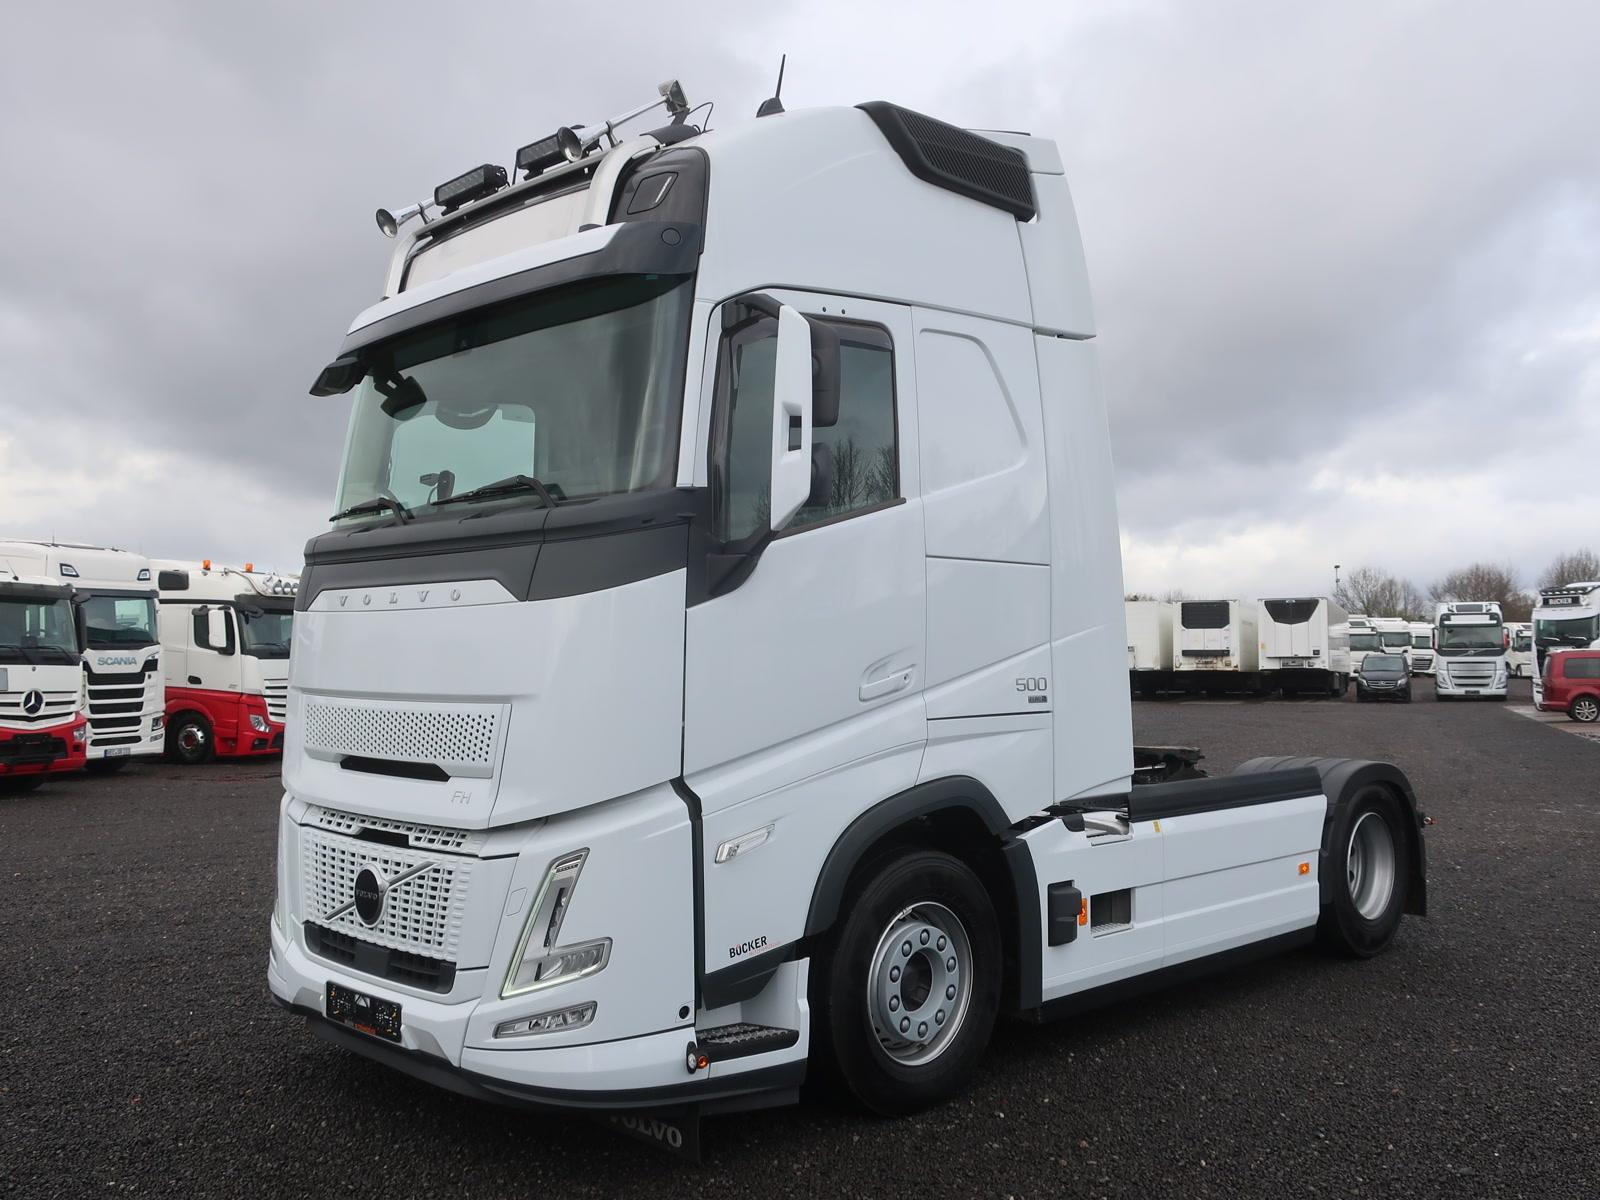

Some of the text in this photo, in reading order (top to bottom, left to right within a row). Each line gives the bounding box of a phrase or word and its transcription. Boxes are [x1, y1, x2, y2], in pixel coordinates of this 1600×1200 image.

[338, 588, 462, 607] VOLVO
[97, 656, 138, 666] SCANIA
[1015, 677, 1048, 692] 500
[450, 790, 473, 805] FH
